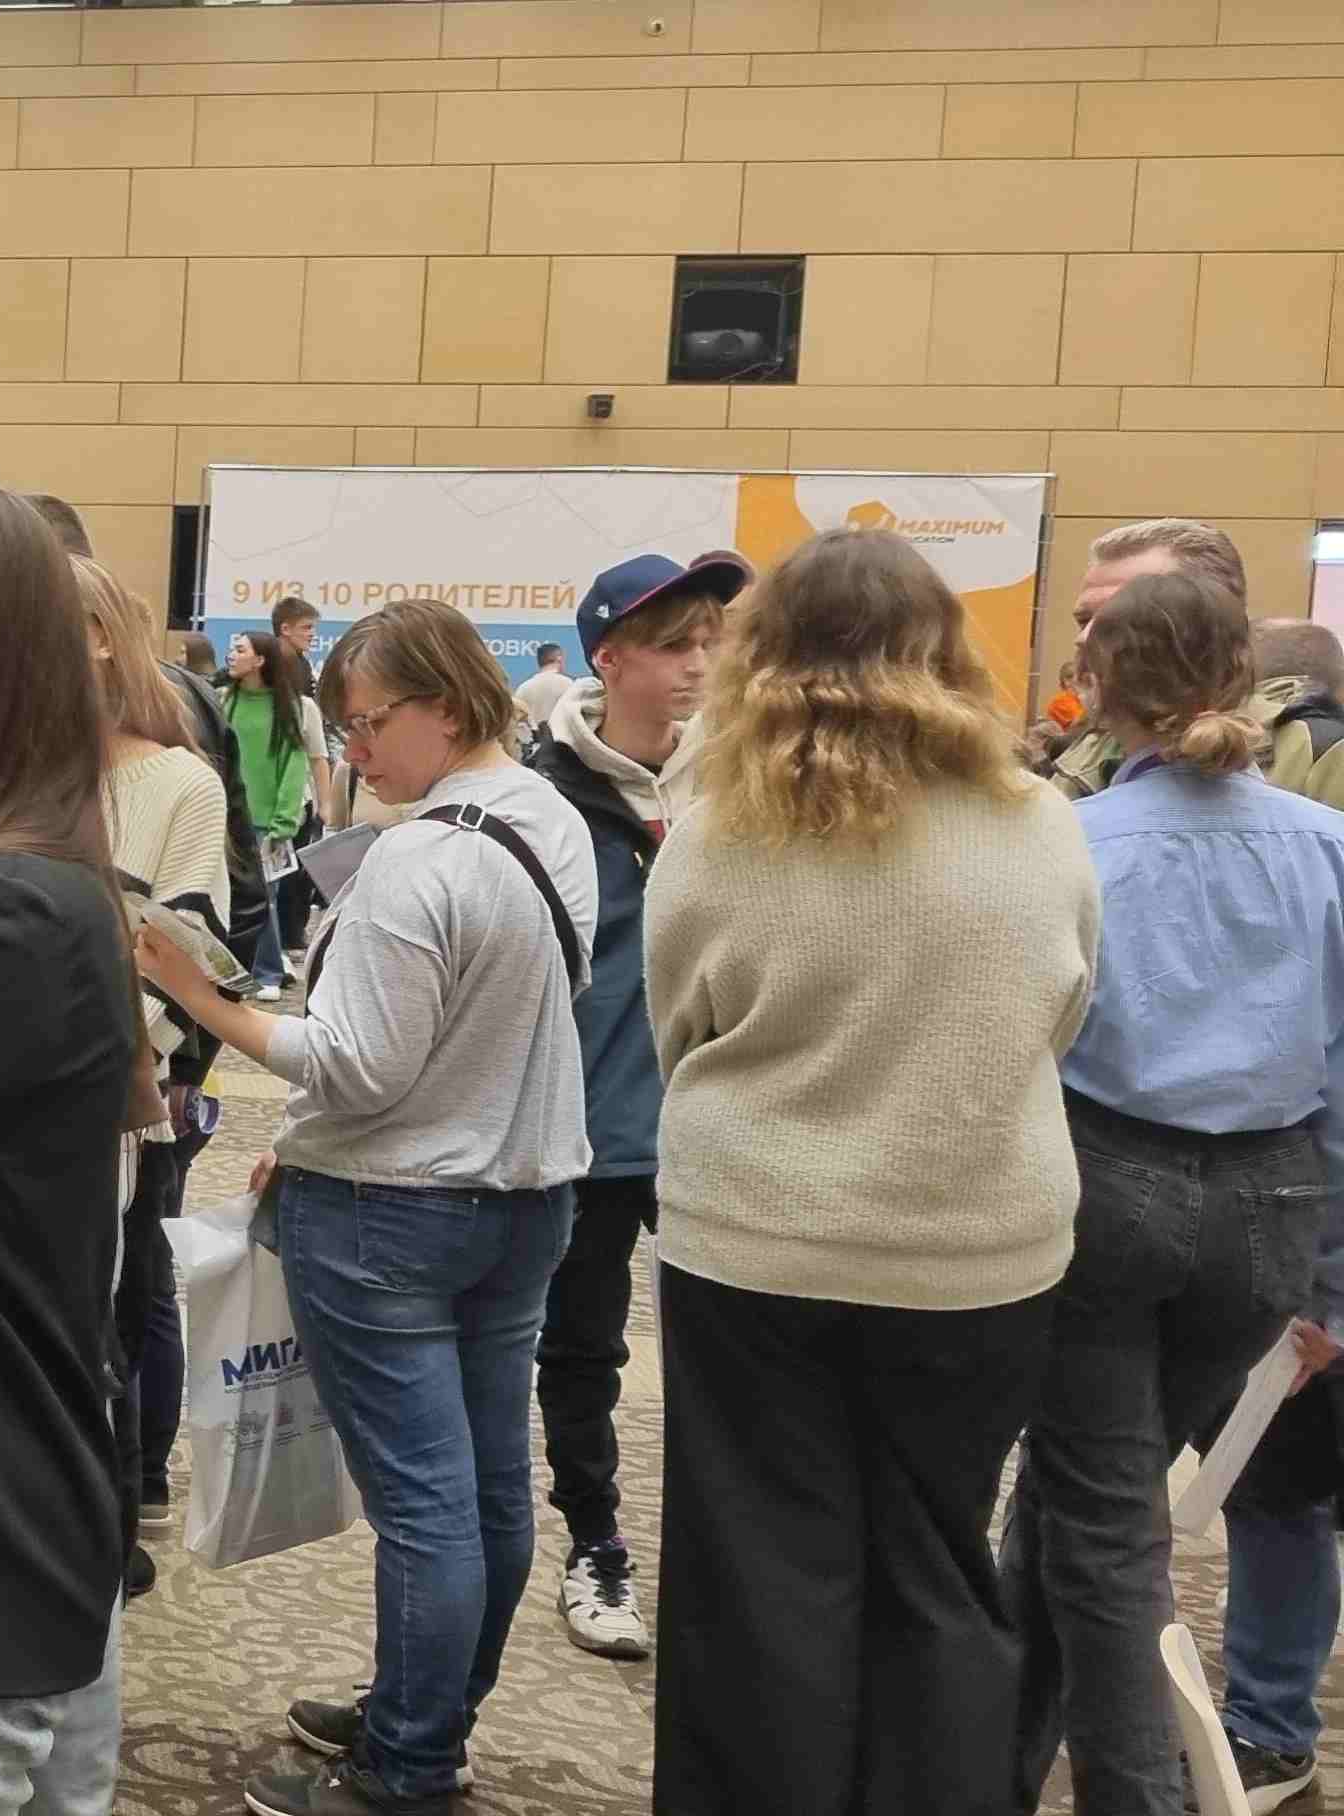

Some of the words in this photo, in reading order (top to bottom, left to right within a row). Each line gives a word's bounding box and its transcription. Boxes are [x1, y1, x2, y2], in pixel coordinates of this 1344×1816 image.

[898, 519, 1005, 535] MAXIMUM
[232, 580, 251, 604] 9
[318, 581, 352, 606] 10
